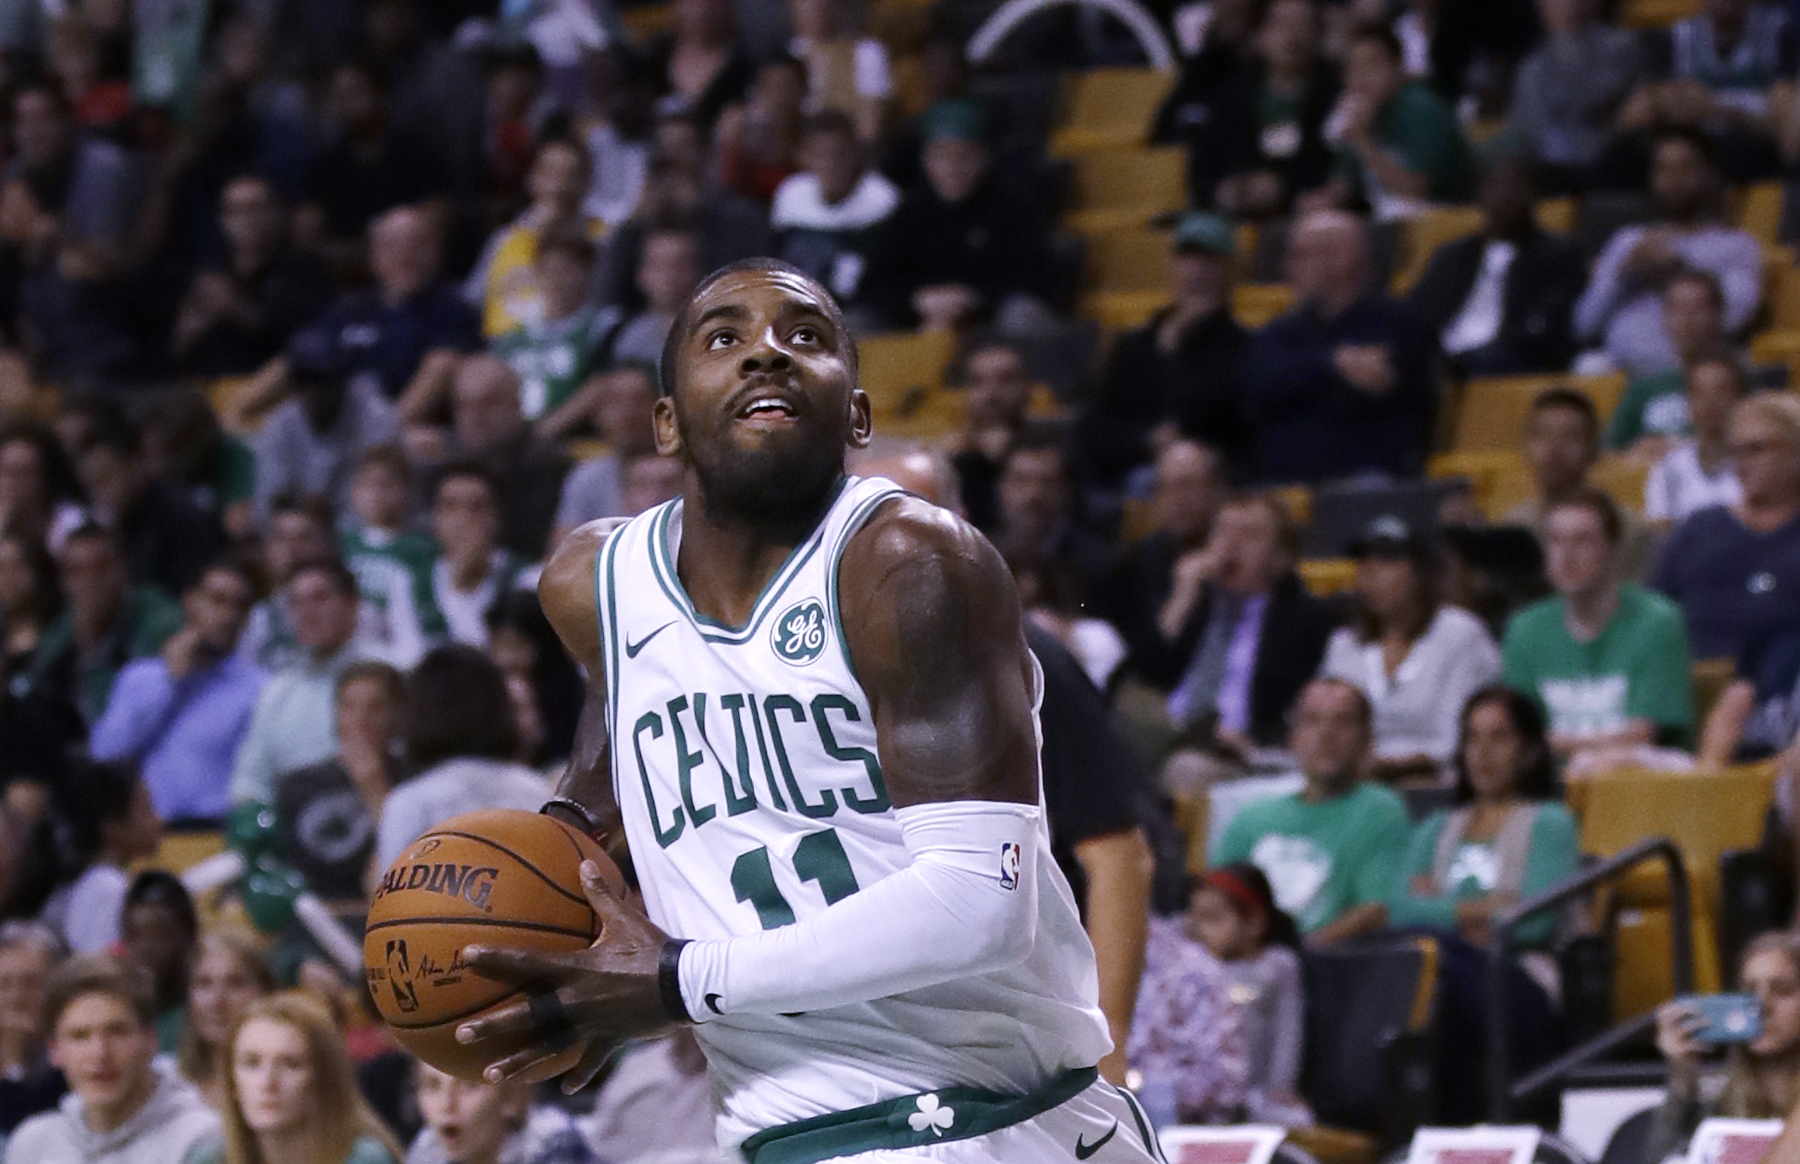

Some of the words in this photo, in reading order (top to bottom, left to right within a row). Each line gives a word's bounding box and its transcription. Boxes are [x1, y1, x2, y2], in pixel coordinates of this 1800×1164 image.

[786, 610, 822, 653] GE
[633, 693, 892, 850] CELTICS
[371, 863, 499, 909] PALDING
[731, 828, 860, 931] 11
